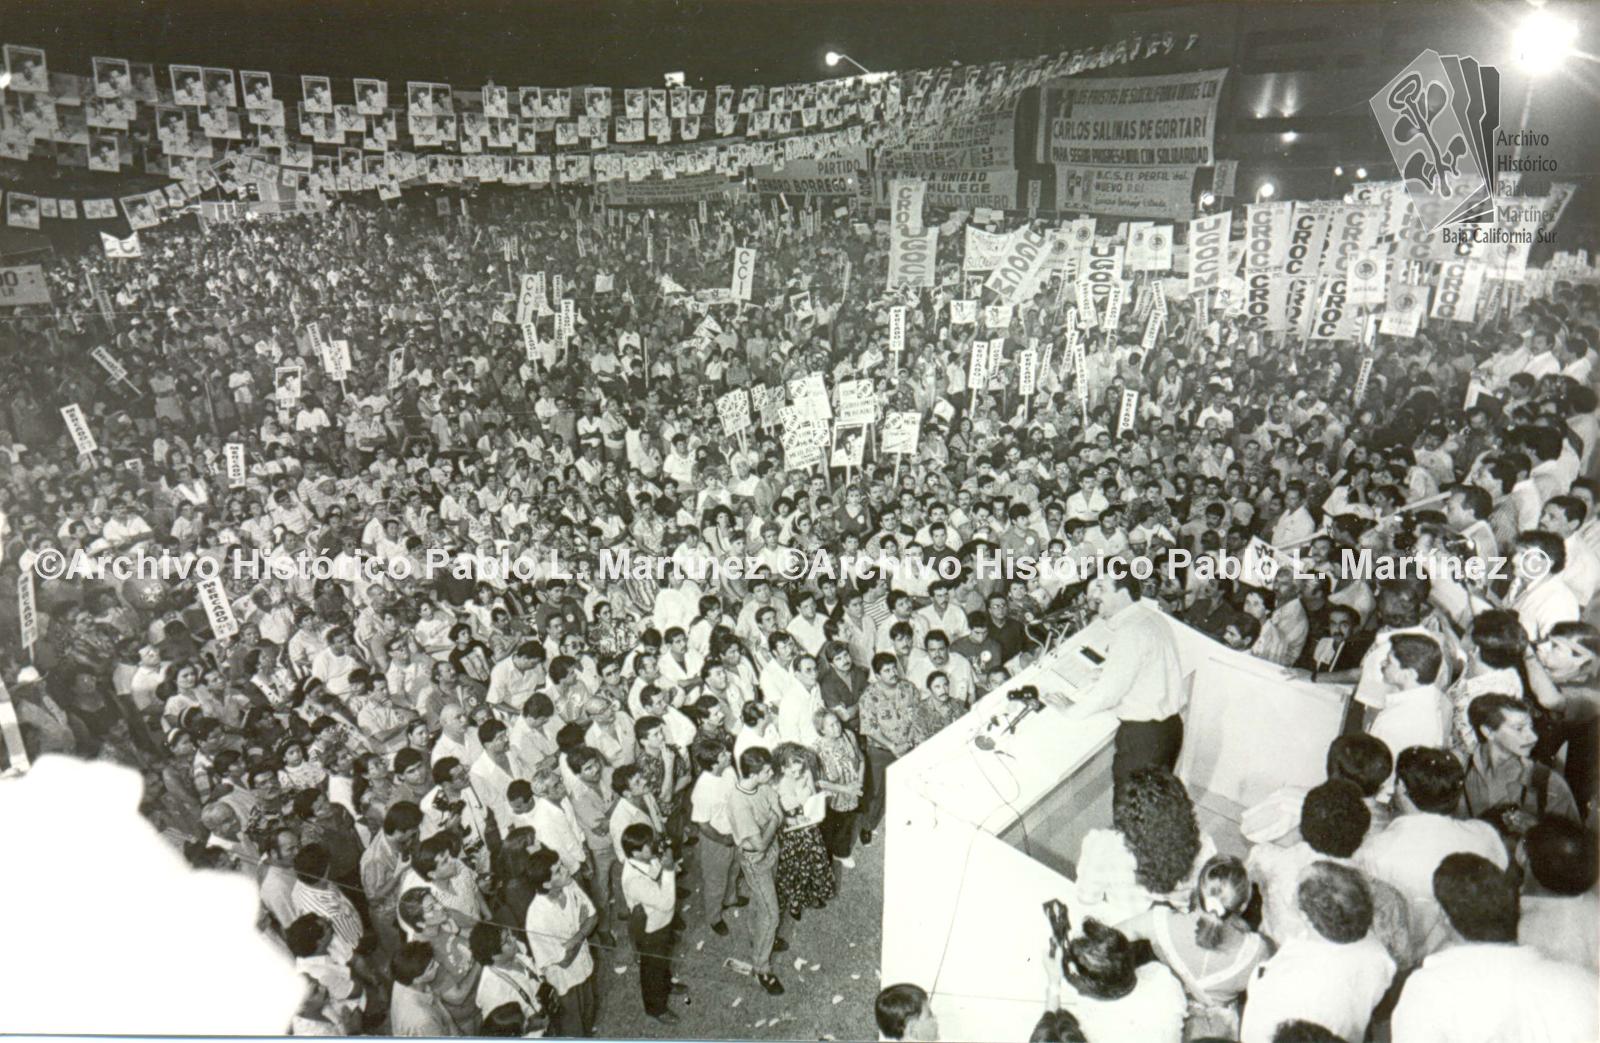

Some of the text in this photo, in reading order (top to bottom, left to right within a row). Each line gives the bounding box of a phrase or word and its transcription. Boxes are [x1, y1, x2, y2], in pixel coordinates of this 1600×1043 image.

[1053, 116, 1207, 141] CARLOS SALINAS DE GORTARI
[817, 159, 860, 175] PARTIDO
[941, 171, 988, 182] UNIDAD
[1138, 171, 1171, 181] PERFIL
[926, 183, 991, 194] MULEGE
[1096, 182, 1122, 193] NUEVO
[896, 187, 913, 229] CRO
[898, 226, 929, 287] UGOCM
[1194, 218, 1222, 288] UGOCM
[1250, 211, 1273, 267] CROC
[1286, 215, 1316, 275] CROC
[737, 250, 750, 296] CCI
[991, 230, 1045, 298] UGOCM
[522, 276, 535, 321] CCI
[1318, 280, 1347, 337] CROC
[1437, 264, 1466, 318] CROC
[524, 324, 536, 351] MERCADO
[893, 309, 901, 340] MERCADO
[973, 344, 985, 377] MERCADO
[1024, 353, 1032, 384] MERCADO
[65, 407, 88, 441] MERCADO
[1122, 392, 1135, 427] MERCADO
[229, 446, 241, 477] MERCADO
[20, 576, 34, 628] MERCADO
[203, 581, 229, 623] MERCADO
